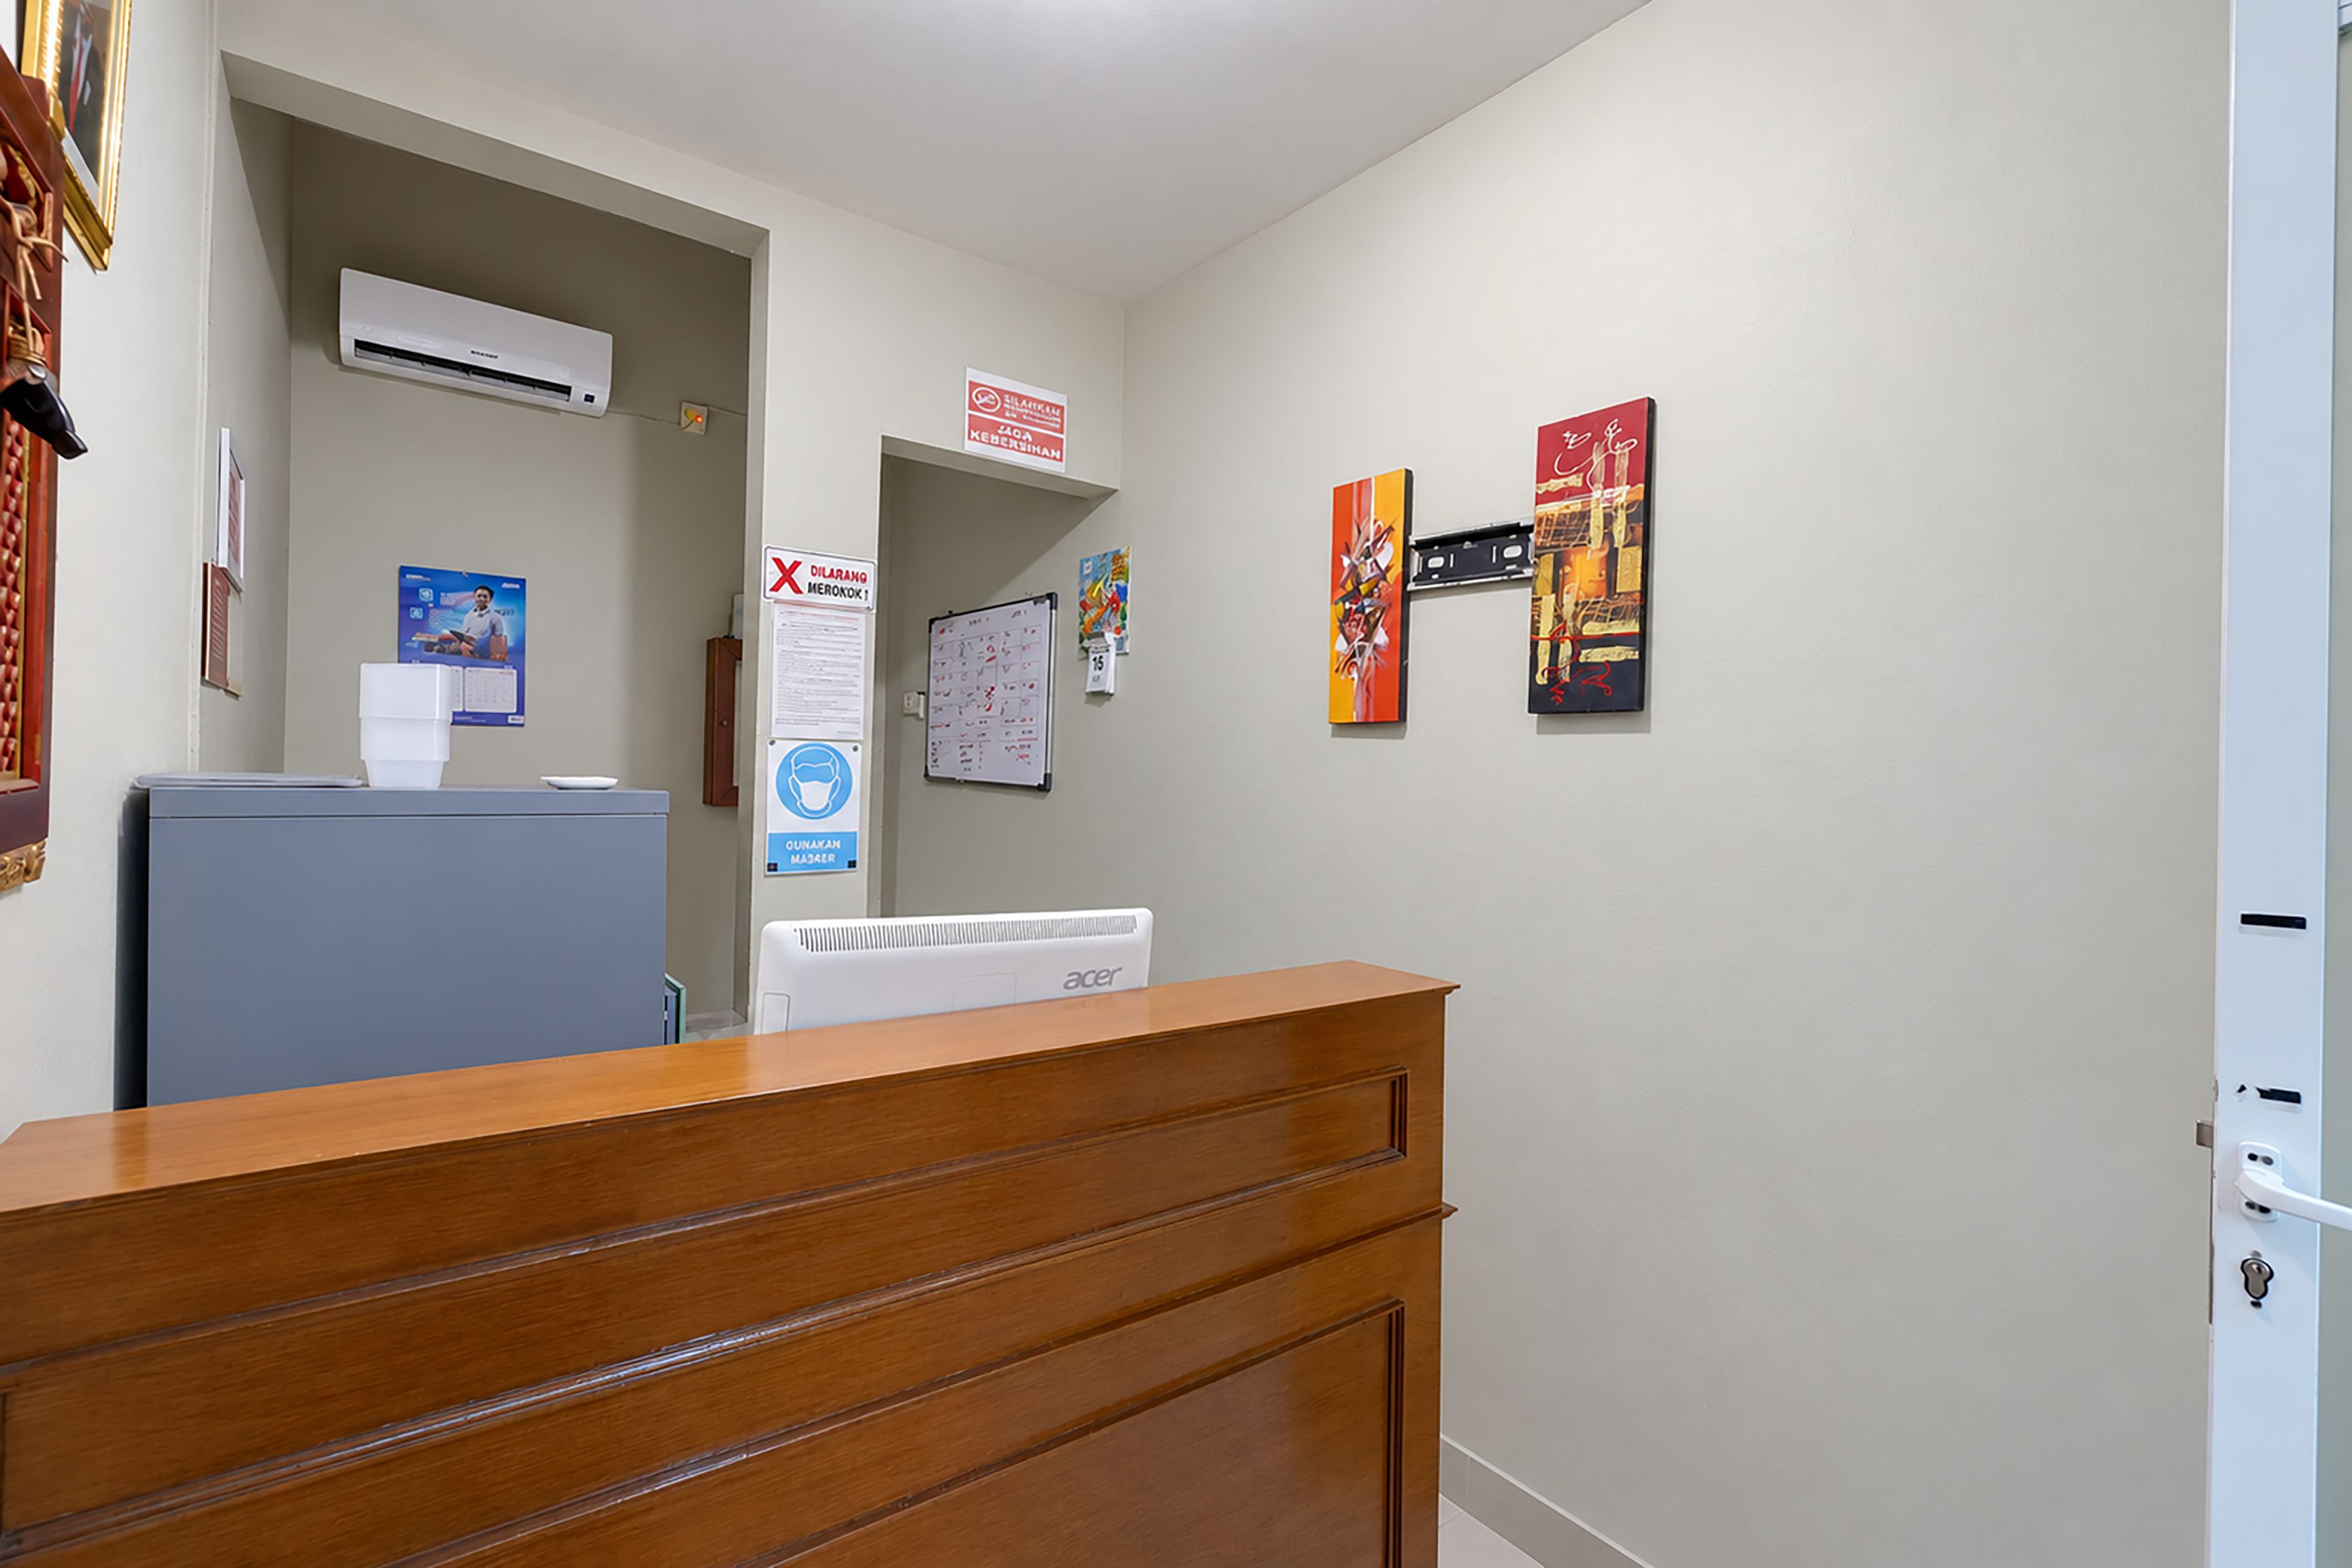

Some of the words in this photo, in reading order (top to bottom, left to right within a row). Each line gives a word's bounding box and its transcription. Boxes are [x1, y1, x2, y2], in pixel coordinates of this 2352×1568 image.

[970, 429, 1061, 459] KEBERSIHAN
[811, 564, 868, 584] DILARANG
[808, 582, 862, 600] MEROKOK
[1063, 966, 1123, 990] acer
